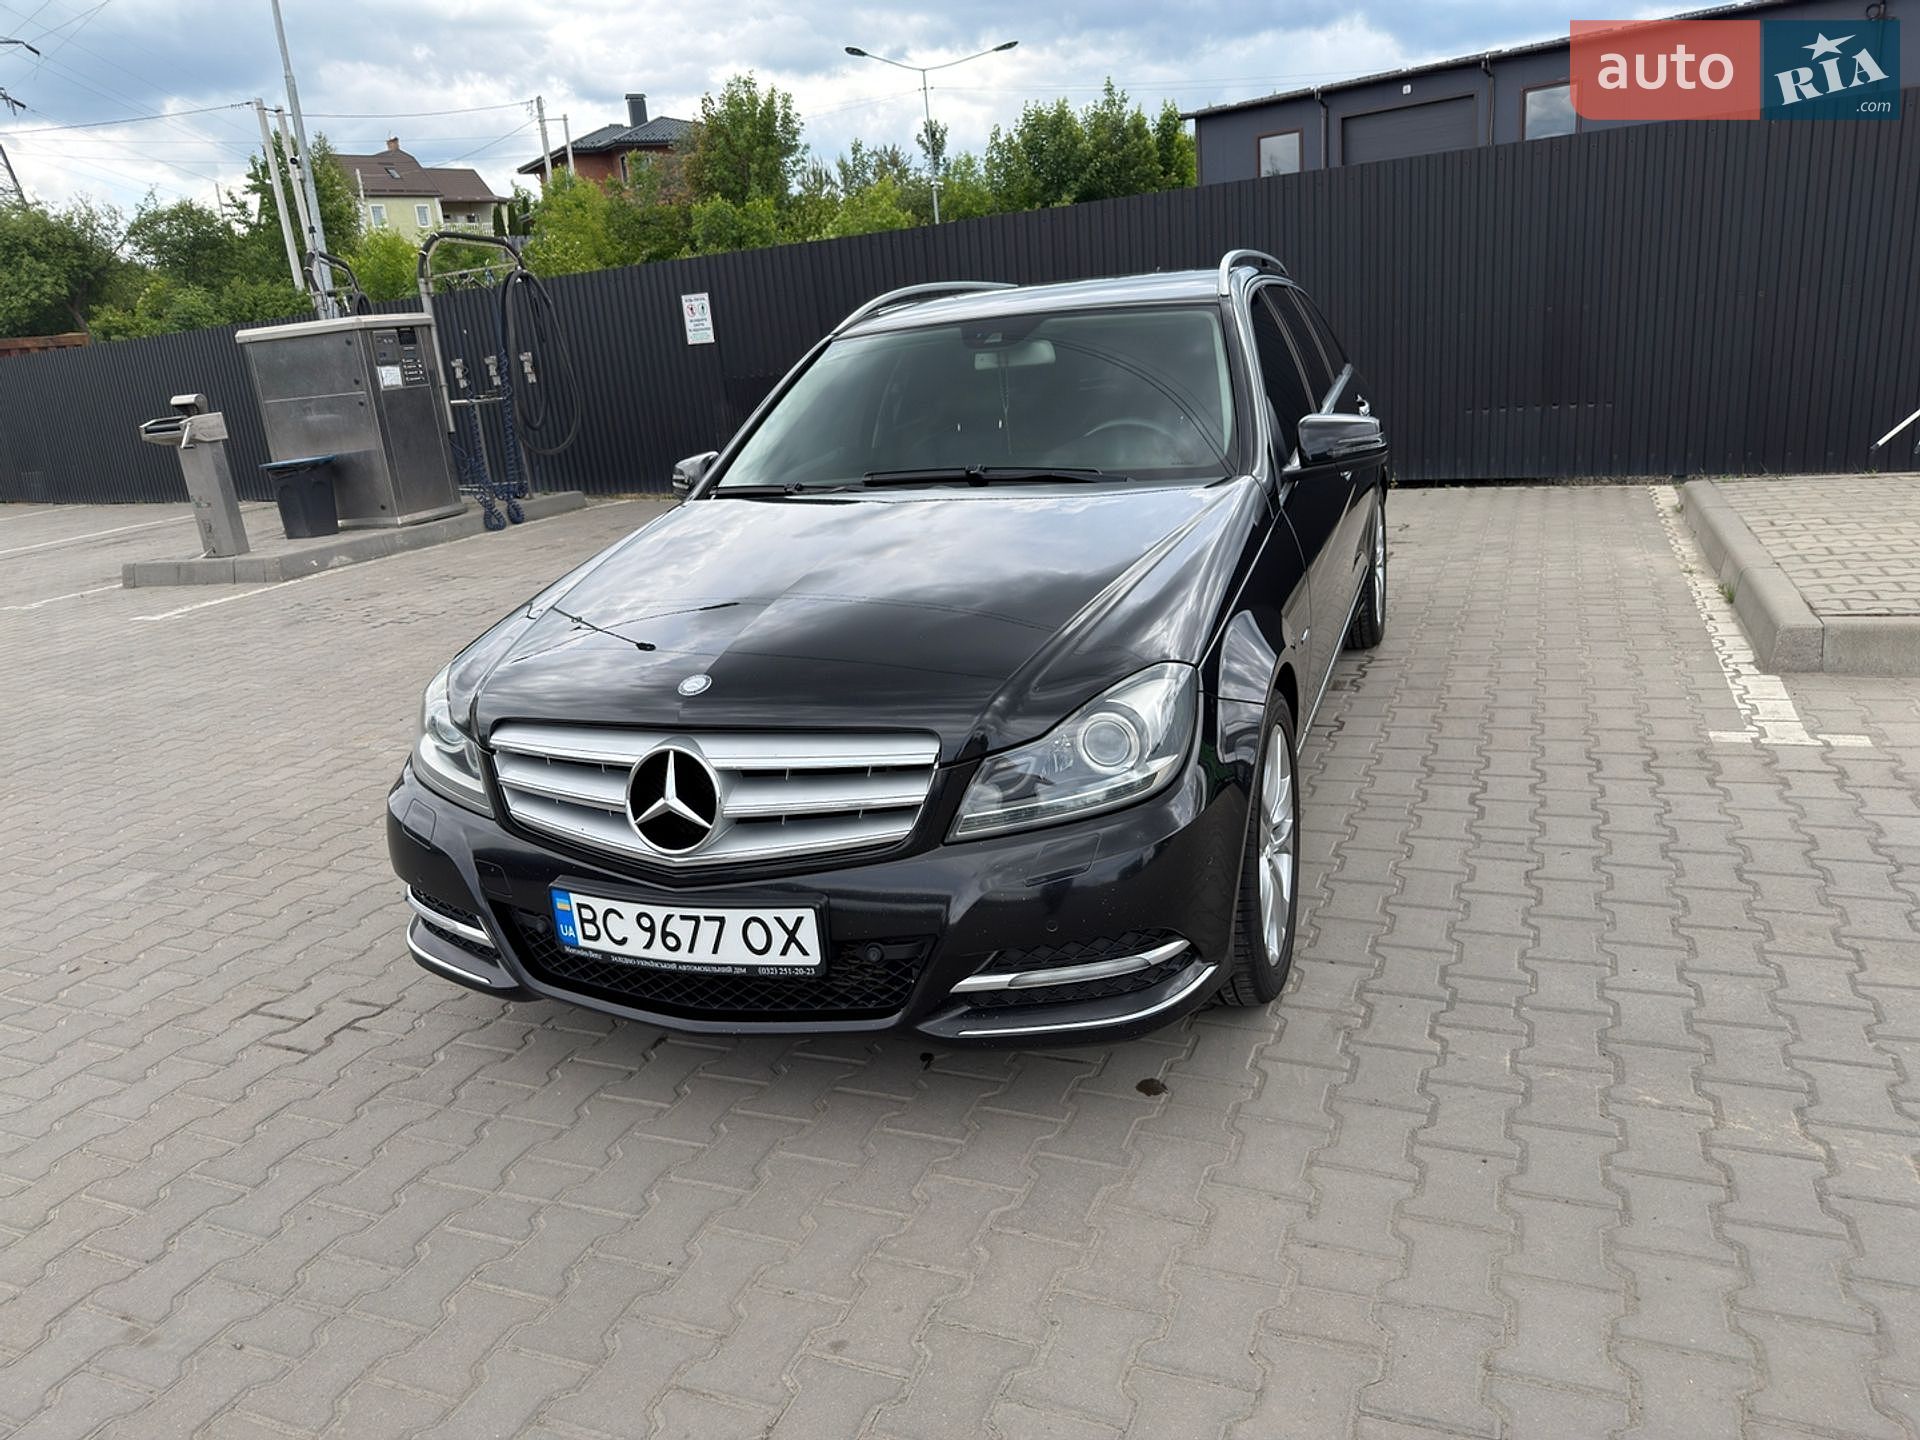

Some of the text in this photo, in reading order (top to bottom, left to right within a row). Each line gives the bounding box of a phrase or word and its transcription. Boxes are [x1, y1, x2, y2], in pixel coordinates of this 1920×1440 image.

[560, 923, 576, 938] UA
[576, 902, 810, 957] BC 9677 OX
[758, 967, 778, 975] (032)
